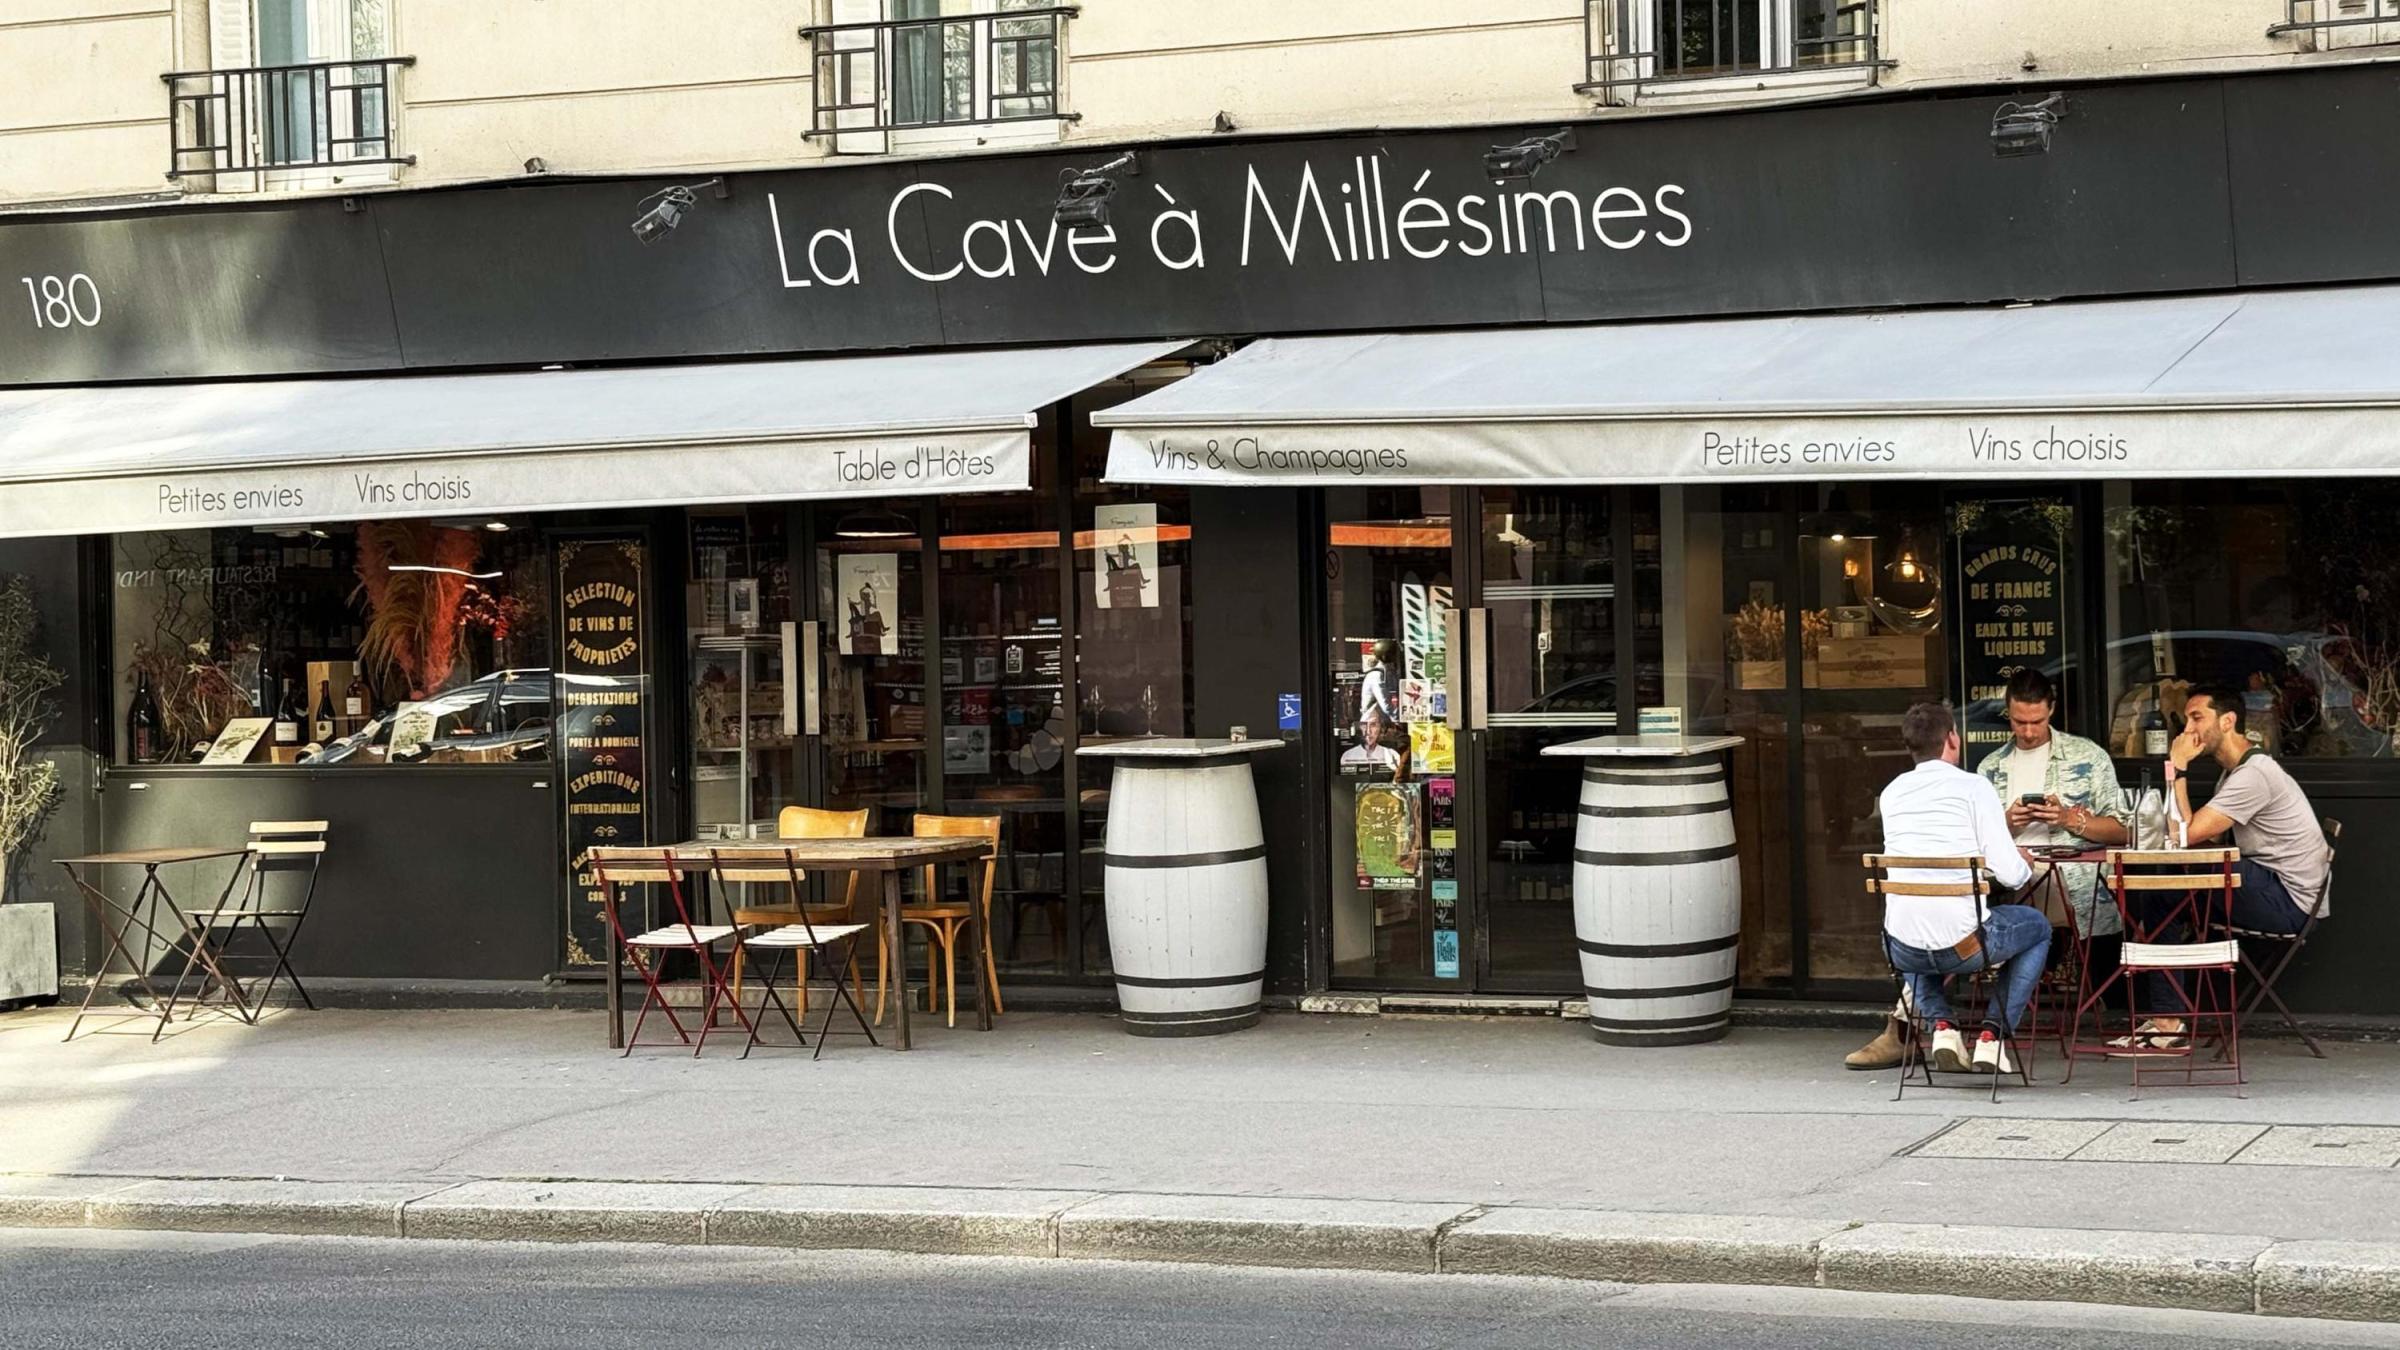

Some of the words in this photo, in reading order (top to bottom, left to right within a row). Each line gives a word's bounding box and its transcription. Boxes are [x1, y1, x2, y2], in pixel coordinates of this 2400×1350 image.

[768, 193, 860, 288] La
[888, 183, 1117, 282] Cave
[1151, 184, 1205, 270] à
[1241, 156, 1692, 266] Millésimes
[22, 273, 102, 328] 180
[1149, 439, 1198, 470] Vins
[1206, 439, 1226, 470] &
[1233, 437, 1408, 475] Champagnes
[1703, 432, 1792, 466] Petites
[1803, 436, 1896, 463] envies
[1968, 427, 2022, 461] Vins
[2032, 425, 2128, 461] choisis
[834, 449, 896, 482] Table
[904, 446, 994, 479] d'Hôtes
[158, 484, 226, 514] Petites
[233, 484, 304, 509] envies
[355, 473, 396, 503] Vins
[402, 470, 471, 501] choisis
[1964, 545, 2017, 577] GRANDS
[2021, 547, 2057, 575] CRUS
[565, 582, 636, 609] SELECTION
[1970, 582, 1989, 600] DE
[1994, 581, 2052, 600] FRANCE
[569, 617, 583, 632] DE
[587, 616, 615, 631] VINS
[619, 616, 634, 631] DE
[1975, 622, 2007, 638] EAUX
[2011, 622, 2028, 637] DE
[2032, 621, 2055, 636] VIE
[567, 636, 638, 666] PROPRIETES
[1984, 640, 2046, 658] LIQUEURS
[568, 692, 639, 706] DEGUSTATIONS
[568, 737, 593, 748] PORTE
[594, 737, 601, 748] A
[602, 736, 640, 748] DOMICILE
[570, 770, 641, 794] EXPEDITIONS
[570, 803, 641, 815] INTERNATIONALES
